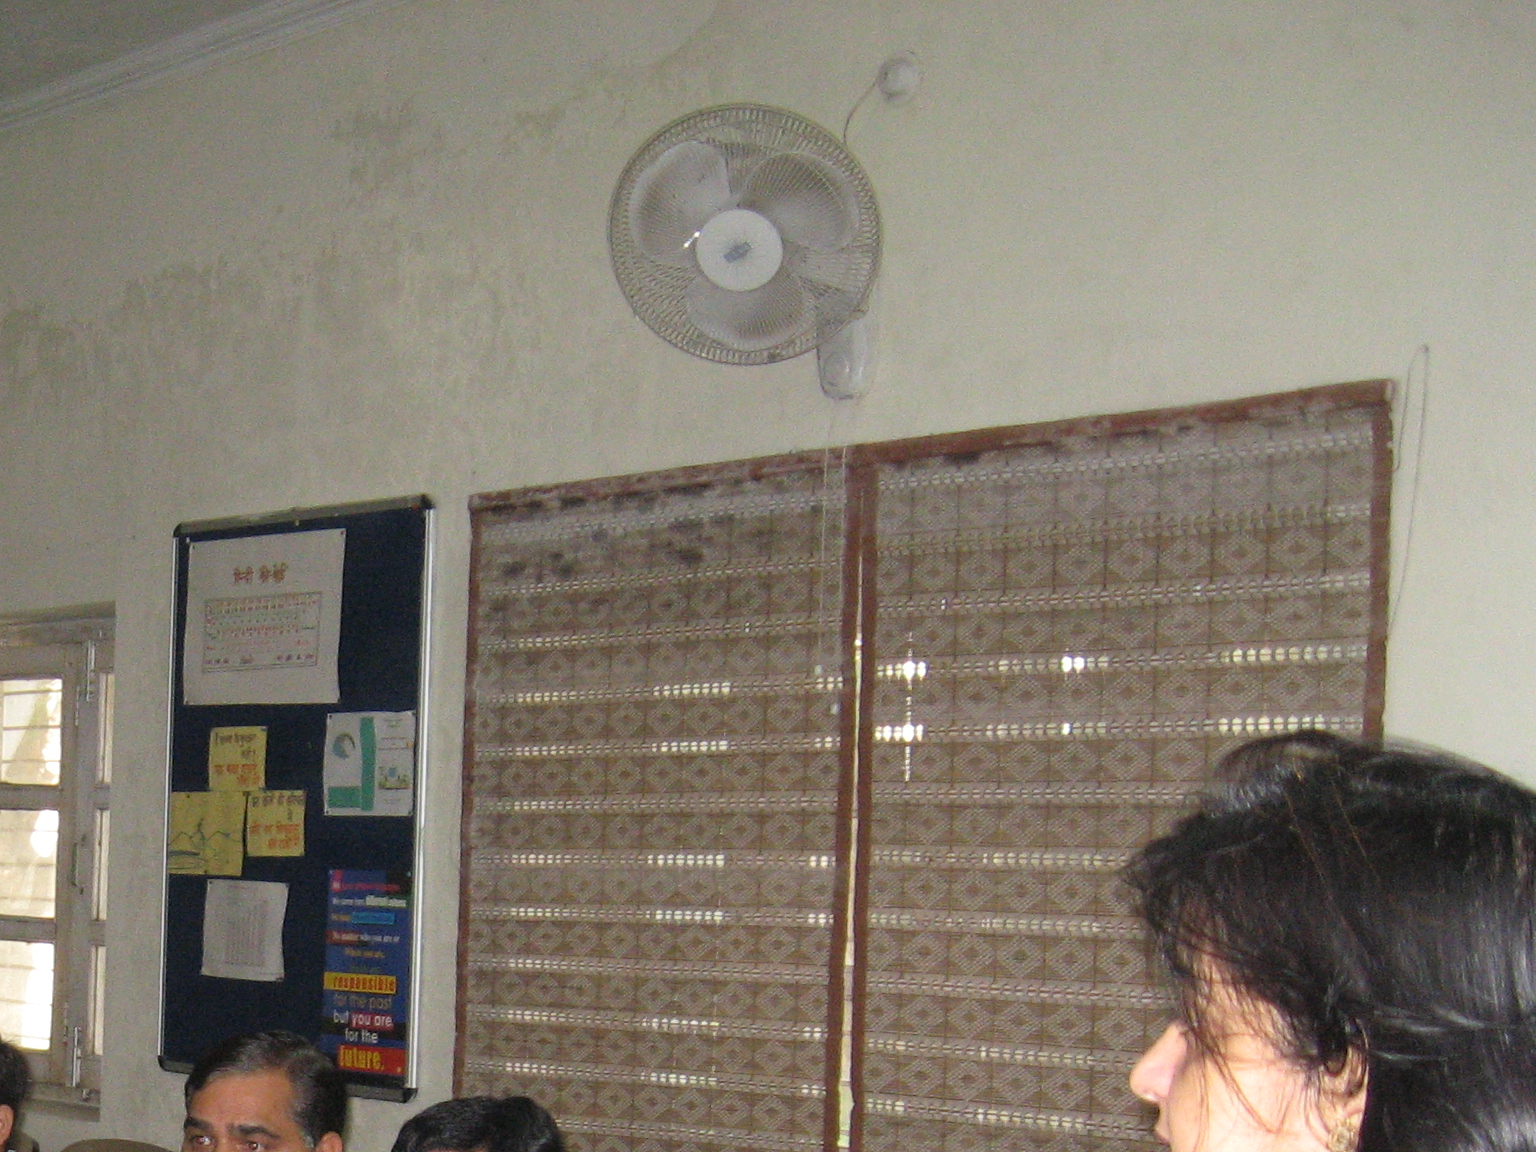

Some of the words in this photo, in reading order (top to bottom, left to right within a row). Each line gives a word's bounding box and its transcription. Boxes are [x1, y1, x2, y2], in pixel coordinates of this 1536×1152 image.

[332, 976, 395, 990] responsible
[349, 994, 366, 1008] the
[369, 996, 391, 1011] past
[333, 1009, 348, 1024] but
[351, 1013, 371, 1028] you
[345, 1027, 358, 1042] for
[361, 1029, 378, 1044] the
